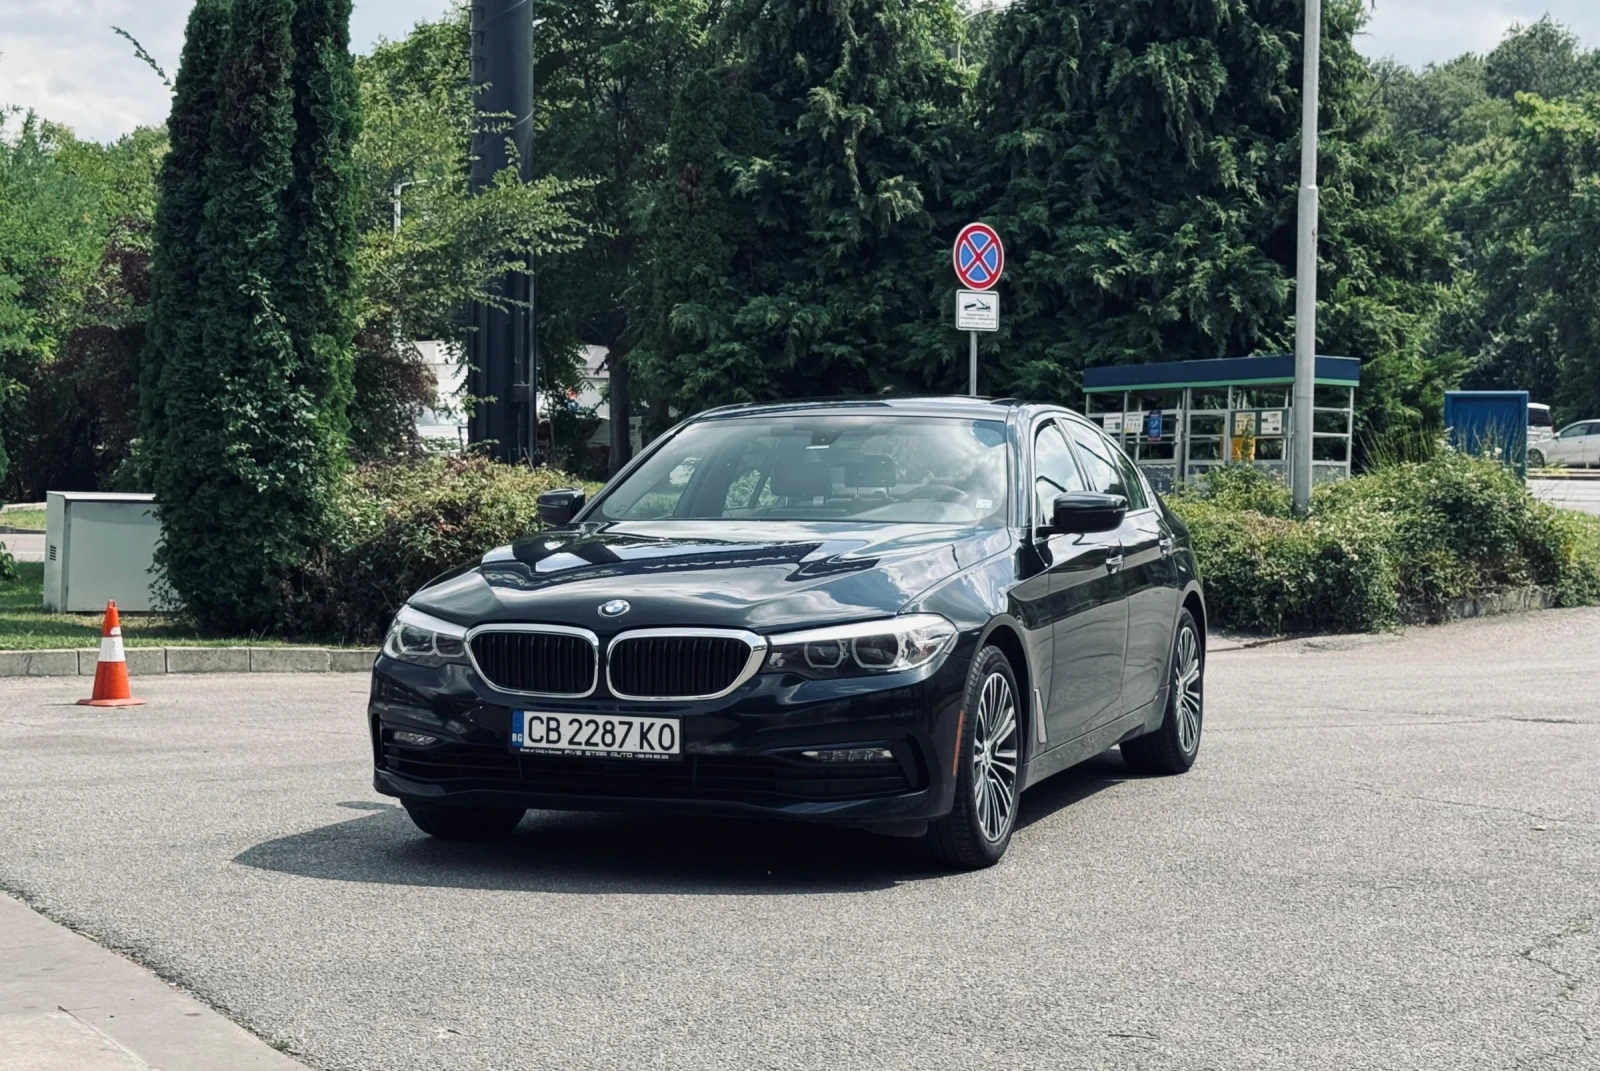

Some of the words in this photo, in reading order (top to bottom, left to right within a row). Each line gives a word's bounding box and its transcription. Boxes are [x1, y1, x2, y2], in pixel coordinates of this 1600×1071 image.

[511, 732, 523, 742] BG
[528, 715, 561, 745] CB
[567, 718, 634, 749] 2287
[639, 721, 676, 751] KO
